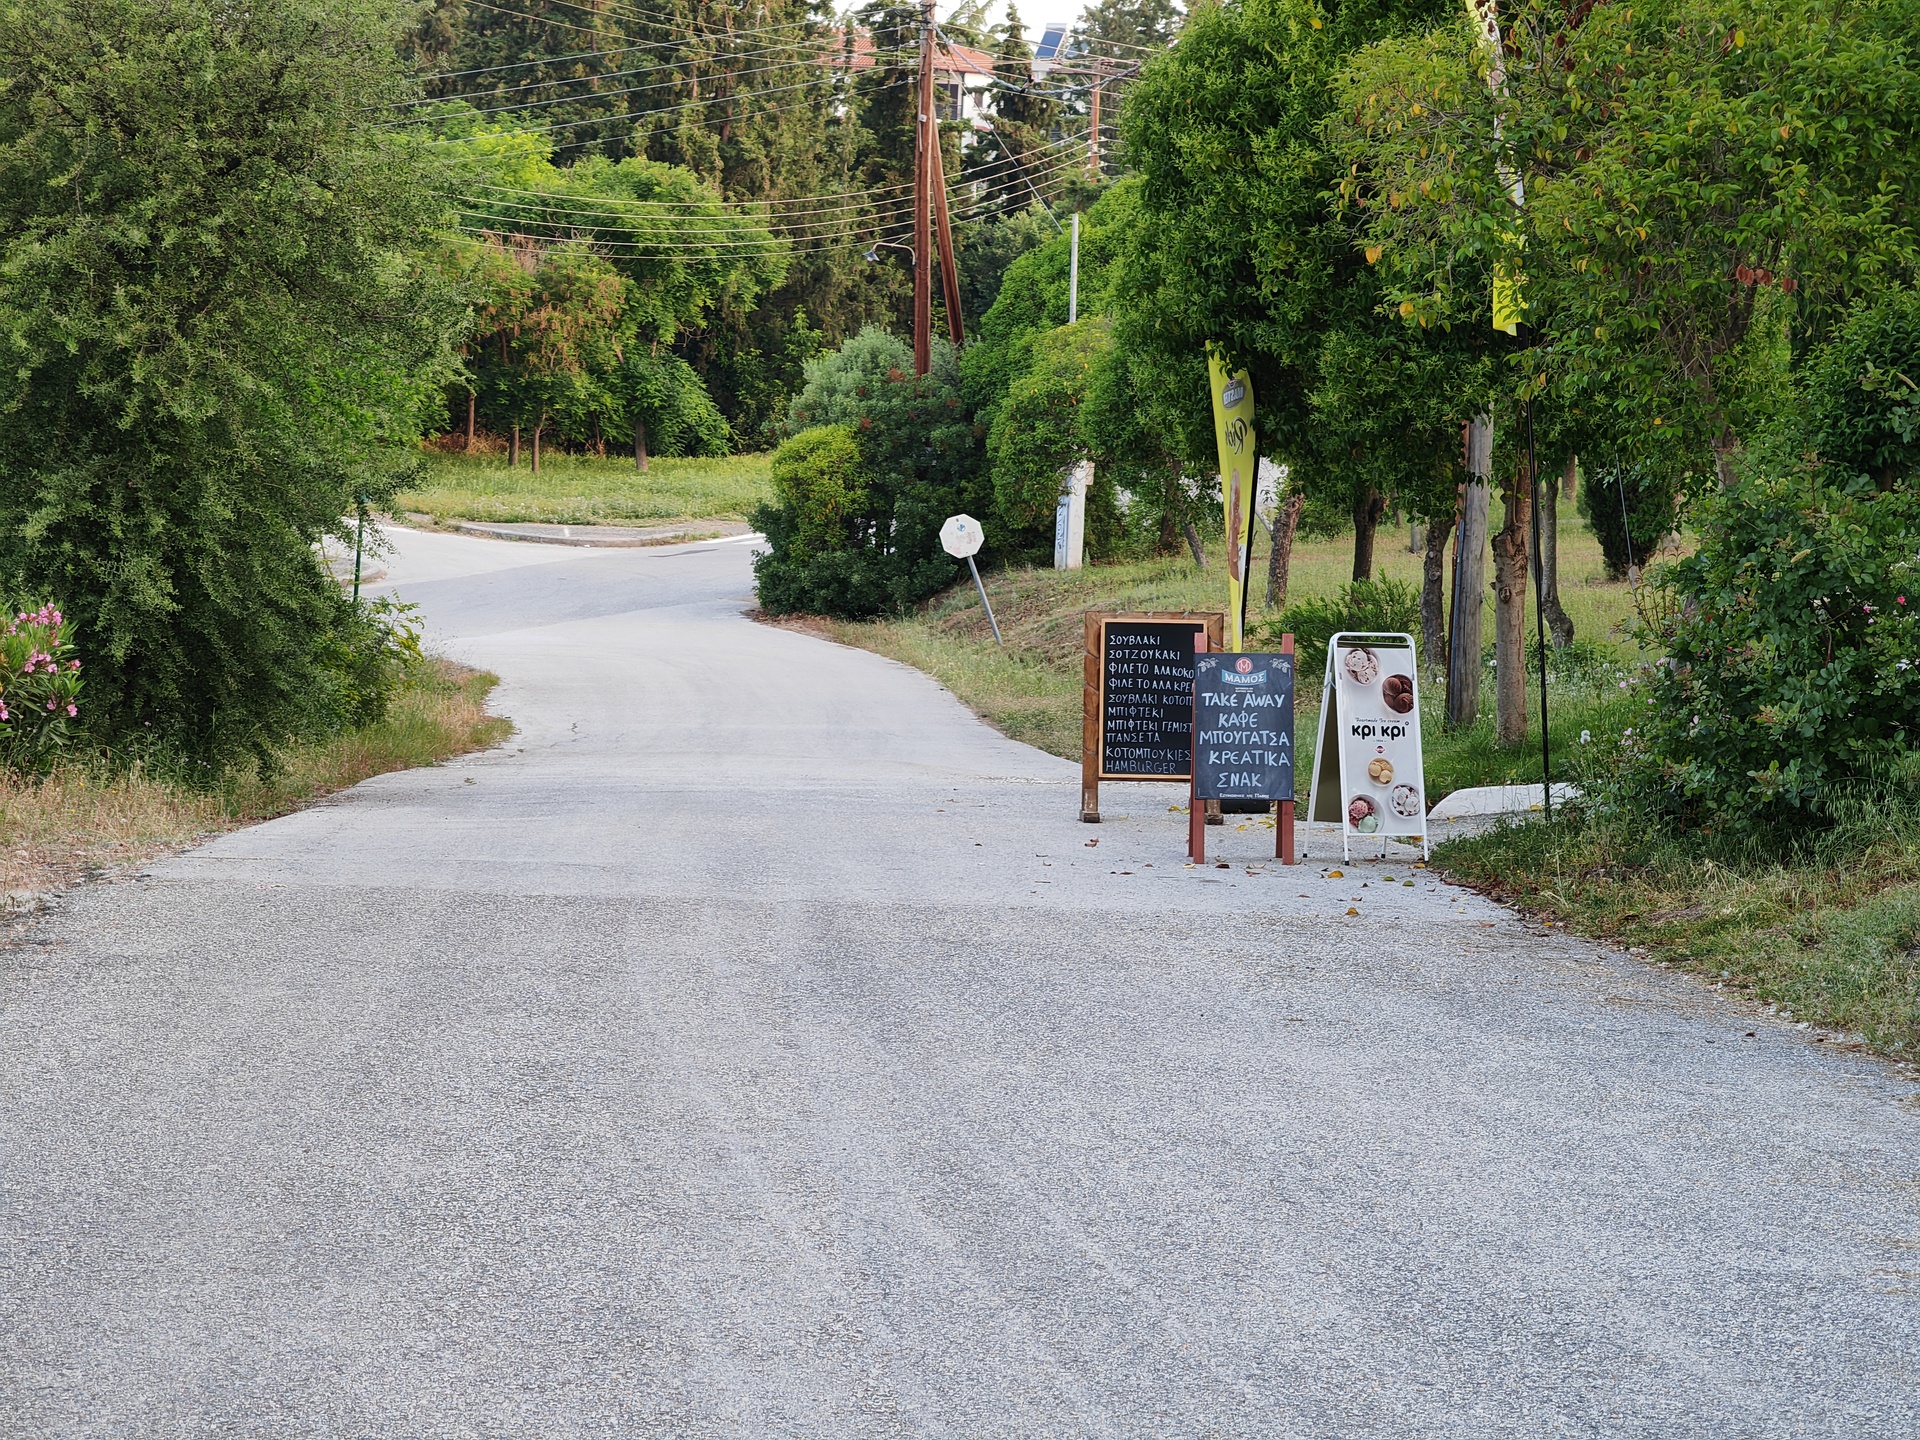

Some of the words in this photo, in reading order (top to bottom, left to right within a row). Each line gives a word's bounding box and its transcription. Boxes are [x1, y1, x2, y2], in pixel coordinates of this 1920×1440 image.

[1109, 634, 1160, 645] ΣΟΥΒΛΑΚΙ
[1108, 649, 1180, 660] ΣΟΤΖΟΥΚΑΚΙ
[1108, 661, 1149, 675] ΦΙΛΕΤΟ
[1154, 664, 1171, 675] ΑΛΑ
[1152, 680, 1172, 690] ΑΛΑ
[1225, 673, 1265, 684] ΜΑΜΟΣ
[1108, 693, 1158, 704] ΣΟΥΒΛΑΚΙ
[1201, 692, 1238, 707] TAKE
[1243, 693, 1285, 708] AWAY
[1108, 706, 1164, 718] ΜΠΙΦΤΕΚΙ
[1107, 719, 1158, 731] ΜΠΙΦΤΕΚΙ
[1218, 710, 1258, 728] ΚΑΦΕ
[1106, 732, 1161, 743] ΠΑΝΣΕΤΑ
[1199, 730, 1290, 747] ΜΠΟΥΓΑΤΣΑ
[1106, 746, 1192, 761] ΚΟΤΟΜΠΟΥΚΙΕΣ
[1208, 750, 1291, 767] ΚΡΕΑΤΙΚΑ
[1106, 760, 1176, 774] HAMBURGER
[1216, 771, 1262, 787] ΣΝΑΚ
